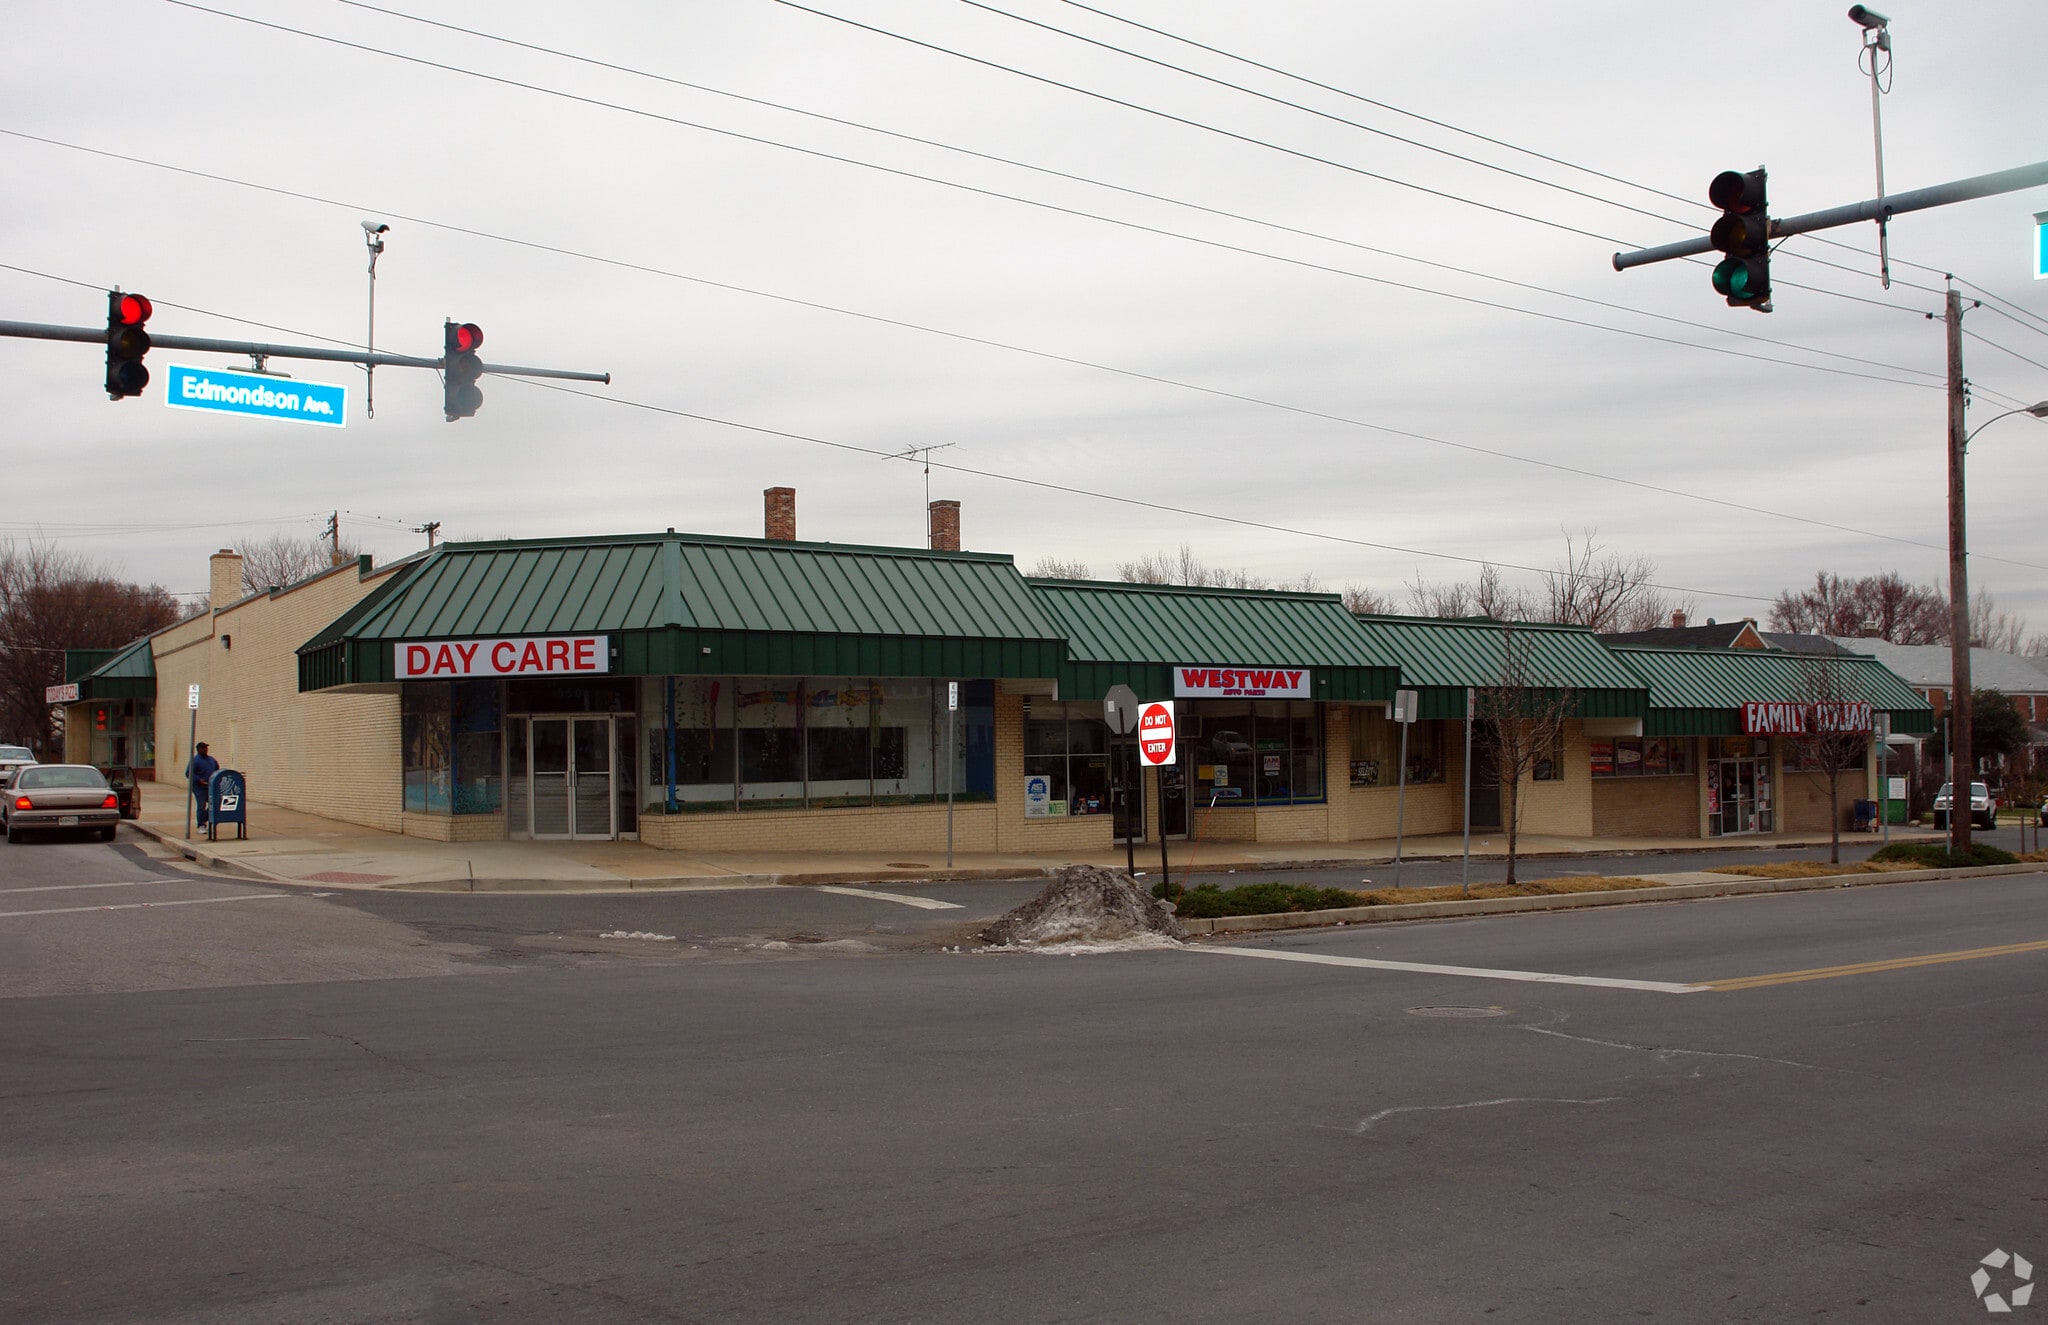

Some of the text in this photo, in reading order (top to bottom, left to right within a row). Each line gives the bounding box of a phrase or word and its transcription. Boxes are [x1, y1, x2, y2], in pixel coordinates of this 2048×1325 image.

[181, 374, 334, 416] Edmondson Ave.
[407, 639, 596, 675] DAY CARE
[1181, 669, 1303, 689] WESTWAY
[1144, 714, 1167, 726] DO NOT
[1747, 703, 1807, 733] FAMILY
[1147, 743, 1166, 753] ENTER
